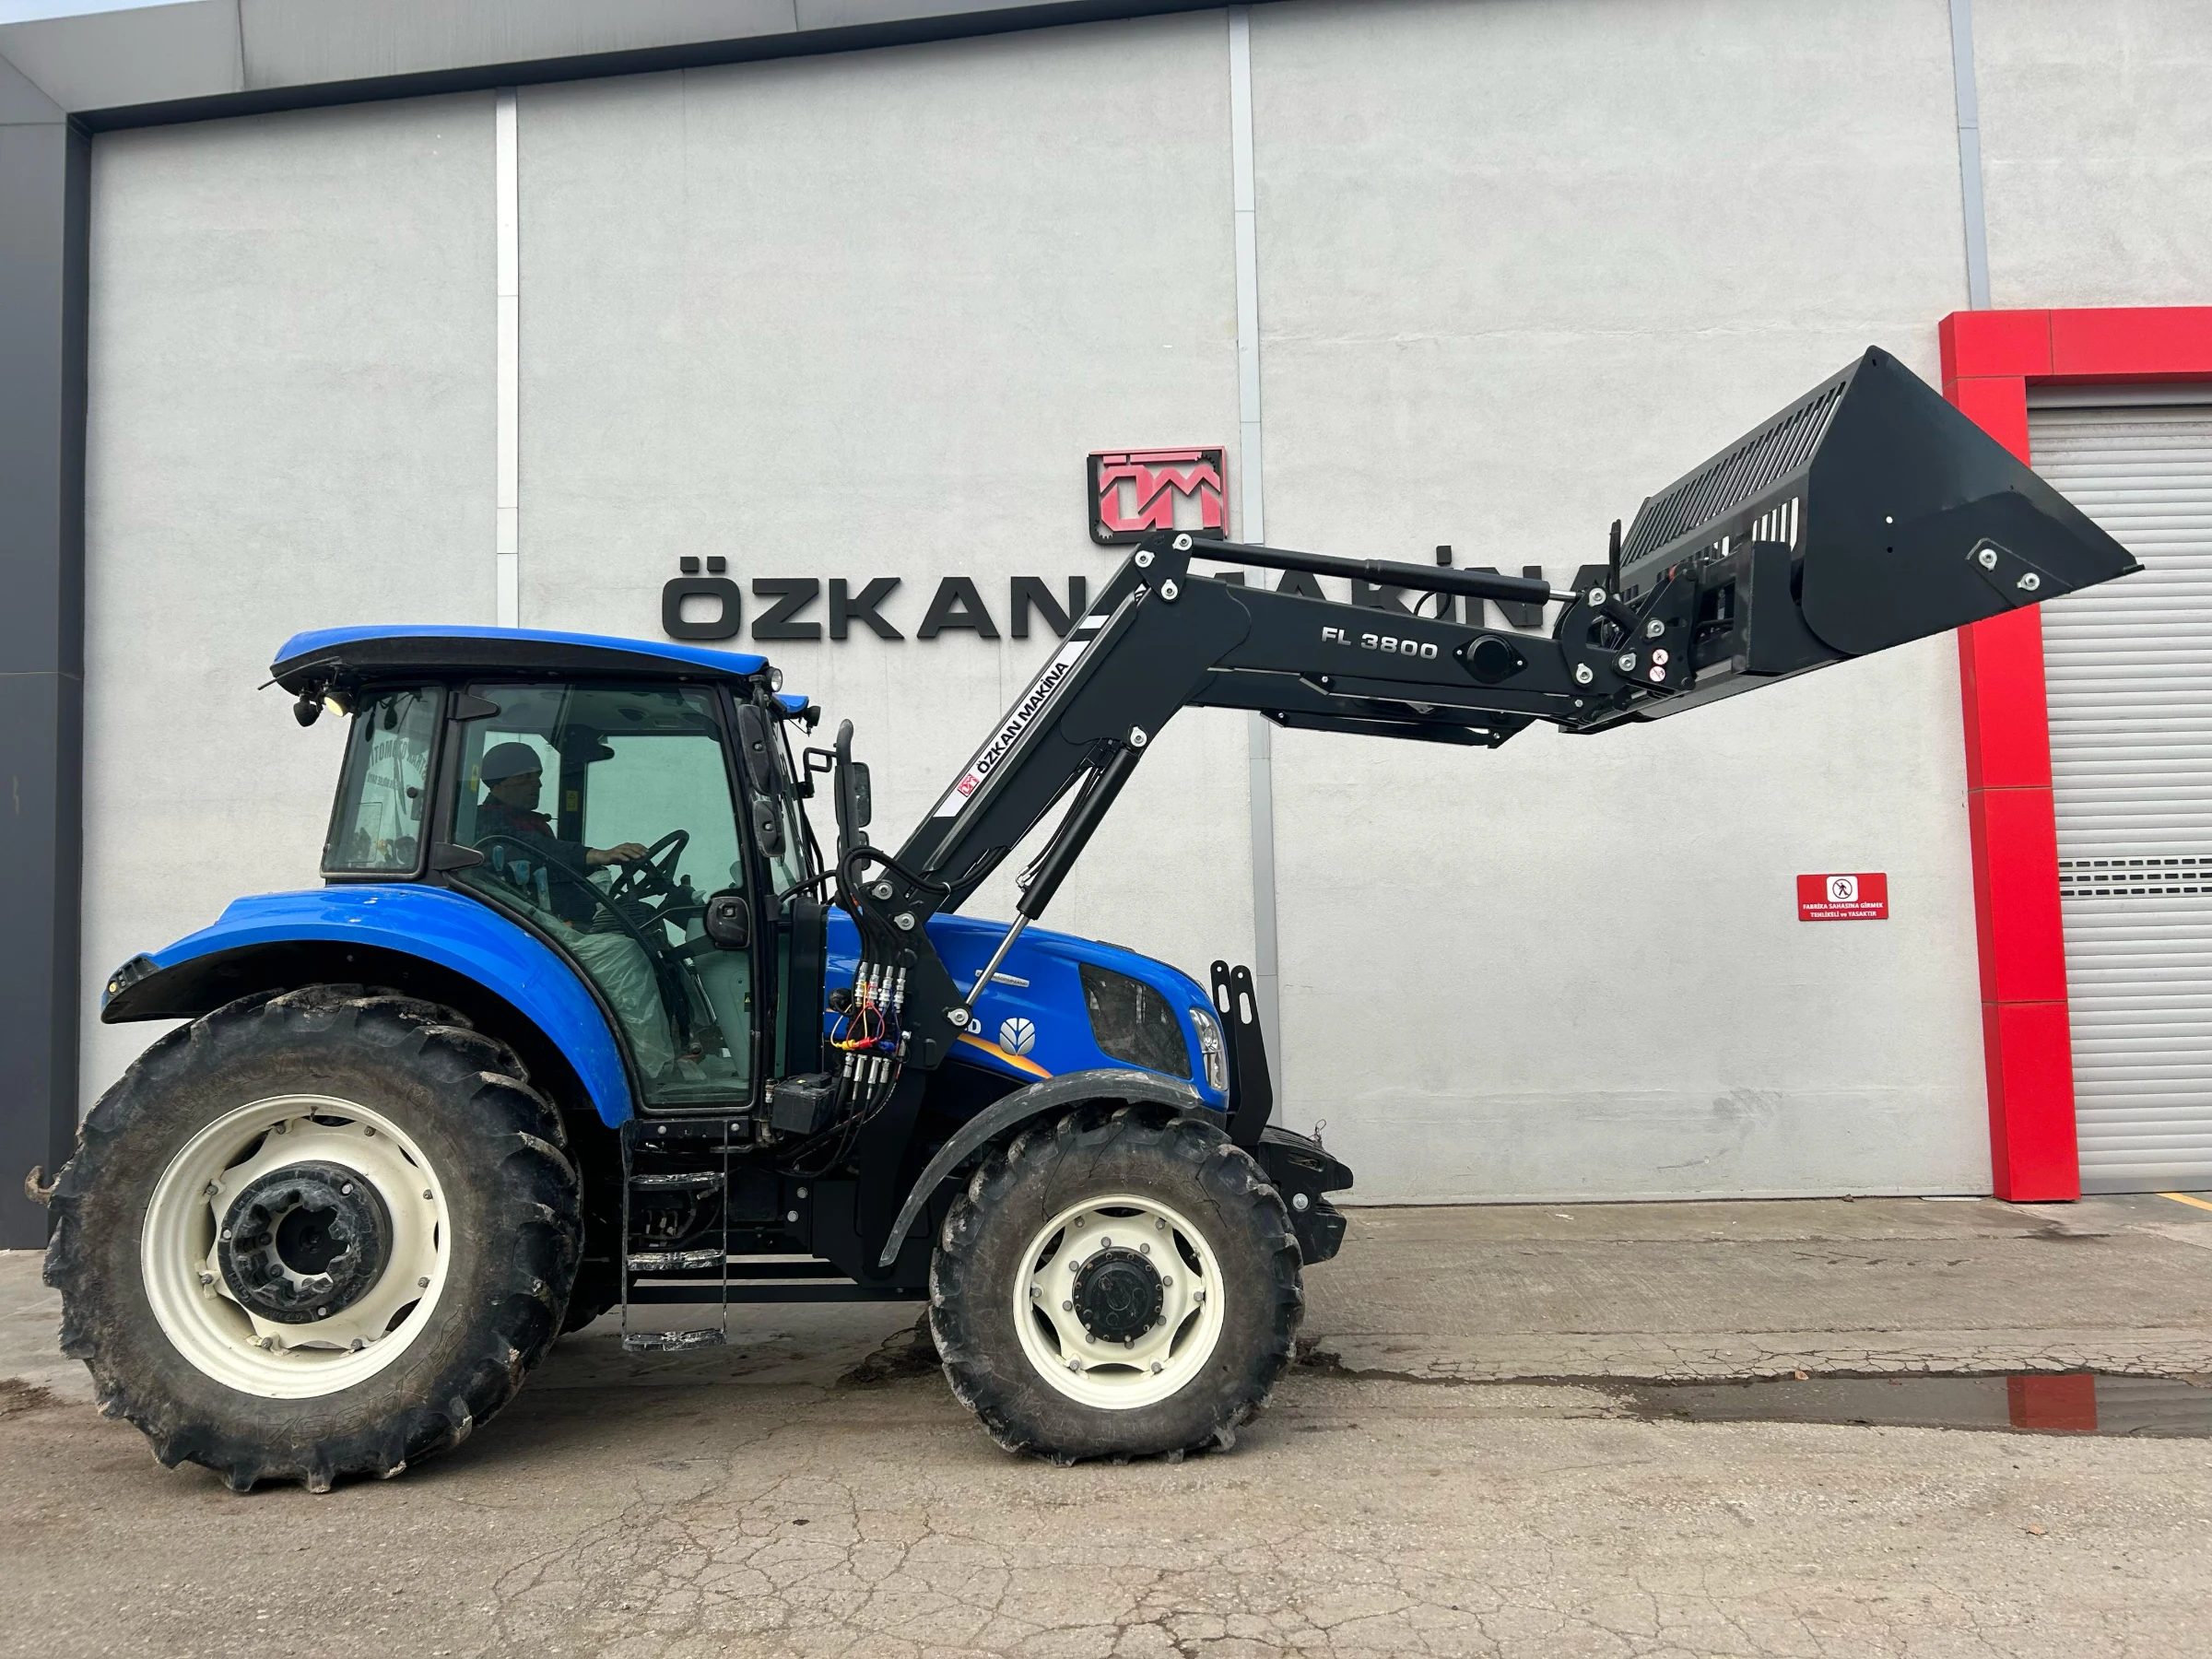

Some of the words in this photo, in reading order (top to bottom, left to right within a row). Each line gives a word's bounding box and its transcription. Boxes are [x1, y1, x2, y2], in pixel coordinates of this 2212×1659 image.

[662, 555, 1087, 641] ÖZKAN
[1321, 626, 1352, 646] FL
[1360, 632, 1439, 660] 3800
[976, 720, 1023, 774] ÖZKAN
[1018, 662, 1070, 722] MAKİNA
